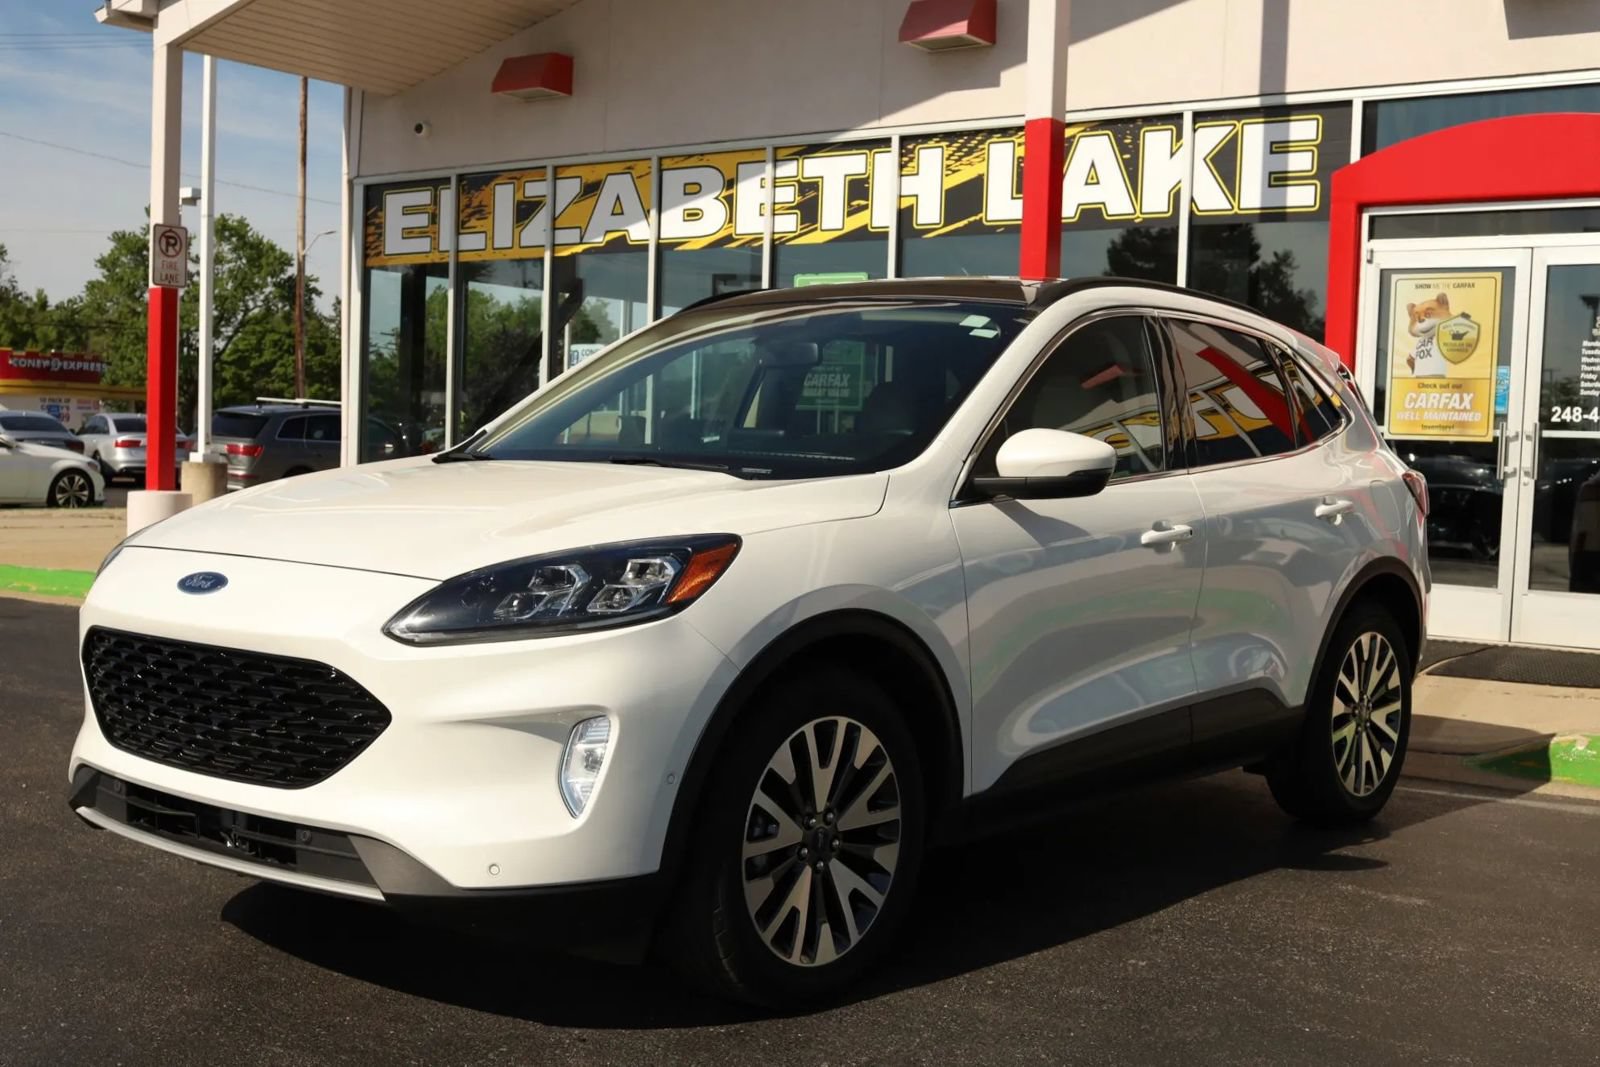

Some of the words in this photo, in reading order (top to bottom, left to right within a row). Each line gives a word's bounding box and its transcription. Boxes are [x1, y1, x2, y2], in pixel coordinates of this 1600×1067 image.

[382, 144, 946, 257] ELIZABETH
[983, 115, 1322, 225] LAKE
[161, 260, 178, 271] FIRE
[160, 273, 180, 283] LANE
[1415, 348, 1433, 360] FOX
[11, 358, 50, 368] CONEY
[63, 361, 108, 373] EXPRESS
[803, 373, 851, 387] CARFAX
[1580, 372, 1598, 381] Friday
[1405, 392, 1474, 410] CARFAX
[1396, 411, 1420, 421] WELL
[1423, 411, 1482, 422] MAINTAINED
[184, 574, 217, 589] Ford
